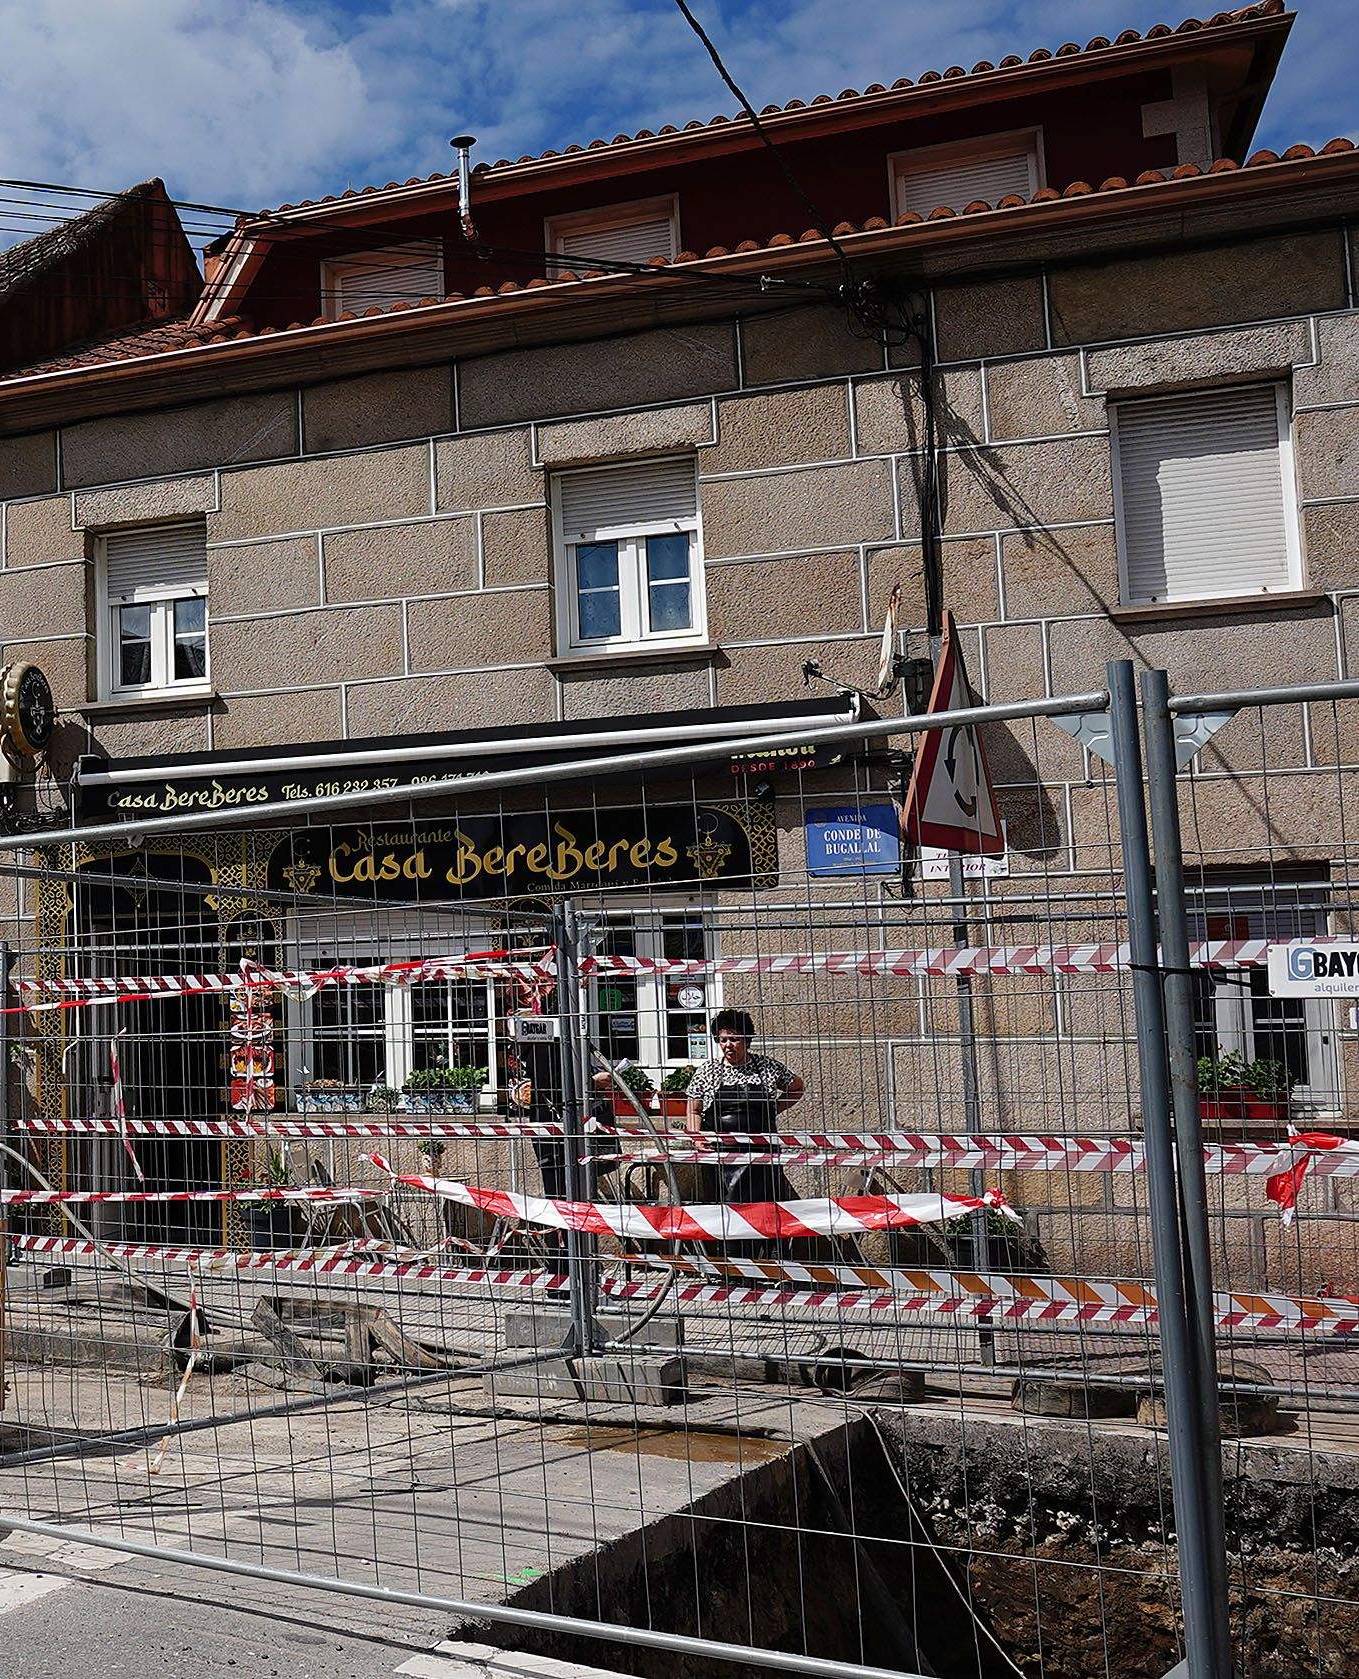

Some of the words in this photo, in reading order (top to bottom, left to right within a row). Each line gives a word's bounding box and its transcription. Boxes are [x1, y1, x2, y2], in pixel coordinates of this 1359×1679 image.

[107, 791, 159, 808] Casa
[159, 779, 269, 811] BereBeres
[281, 783, 313, 800] Tels.
[315, 781, 340, 797] 616
[351, 828, 453, 853] Restaurante
[823, 828, 861, 842] CONDE
[866, 828, 882, 839] DE
[328, 841, 433, 883] Casa
[445, 820, 678, 885] BereBeres
[1312, 951, 1359, 977] BAY
